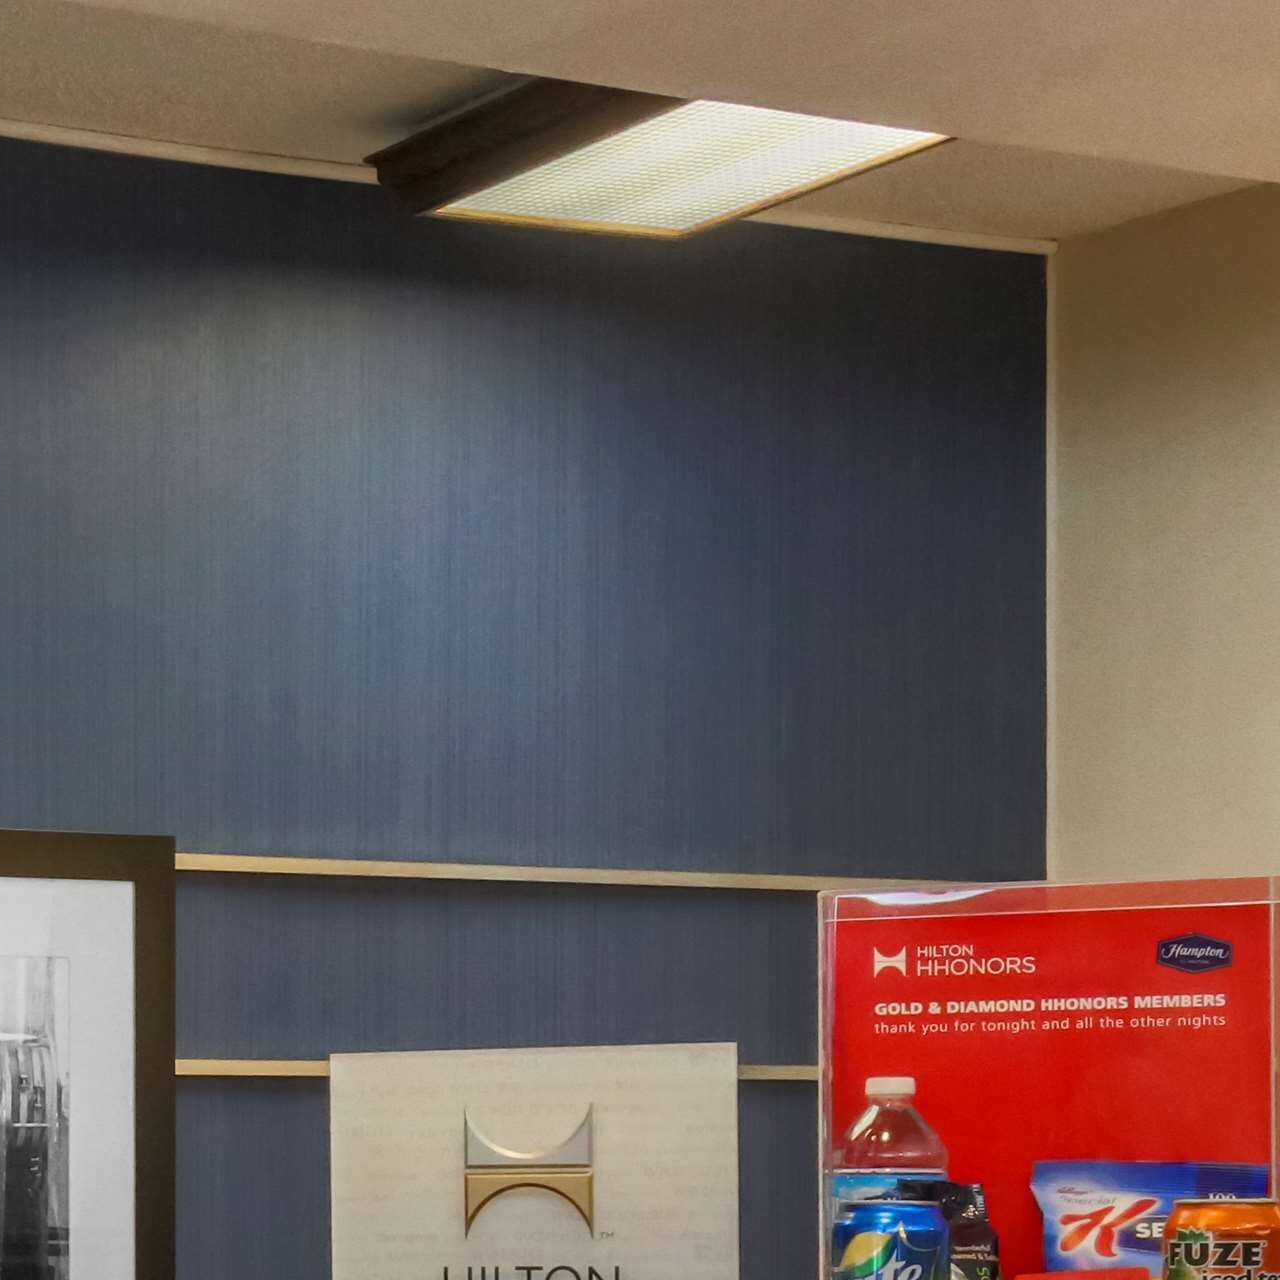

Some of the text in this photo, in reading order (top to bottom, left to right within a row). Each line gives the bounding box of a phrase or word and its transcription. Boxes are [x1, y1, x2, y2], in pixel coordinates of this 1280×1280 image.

[916, 944, 974, 958] HILTON
[1161, 943, 1229, 959] Hampton
[916, 957, 1037, 977] HHONORS
[874, 993, 1227, 1016] GOLD & DIAMOND HHONORS MEMBERS
[874, 1013, 1226, 1036] thank you for tonight and all the other nights
